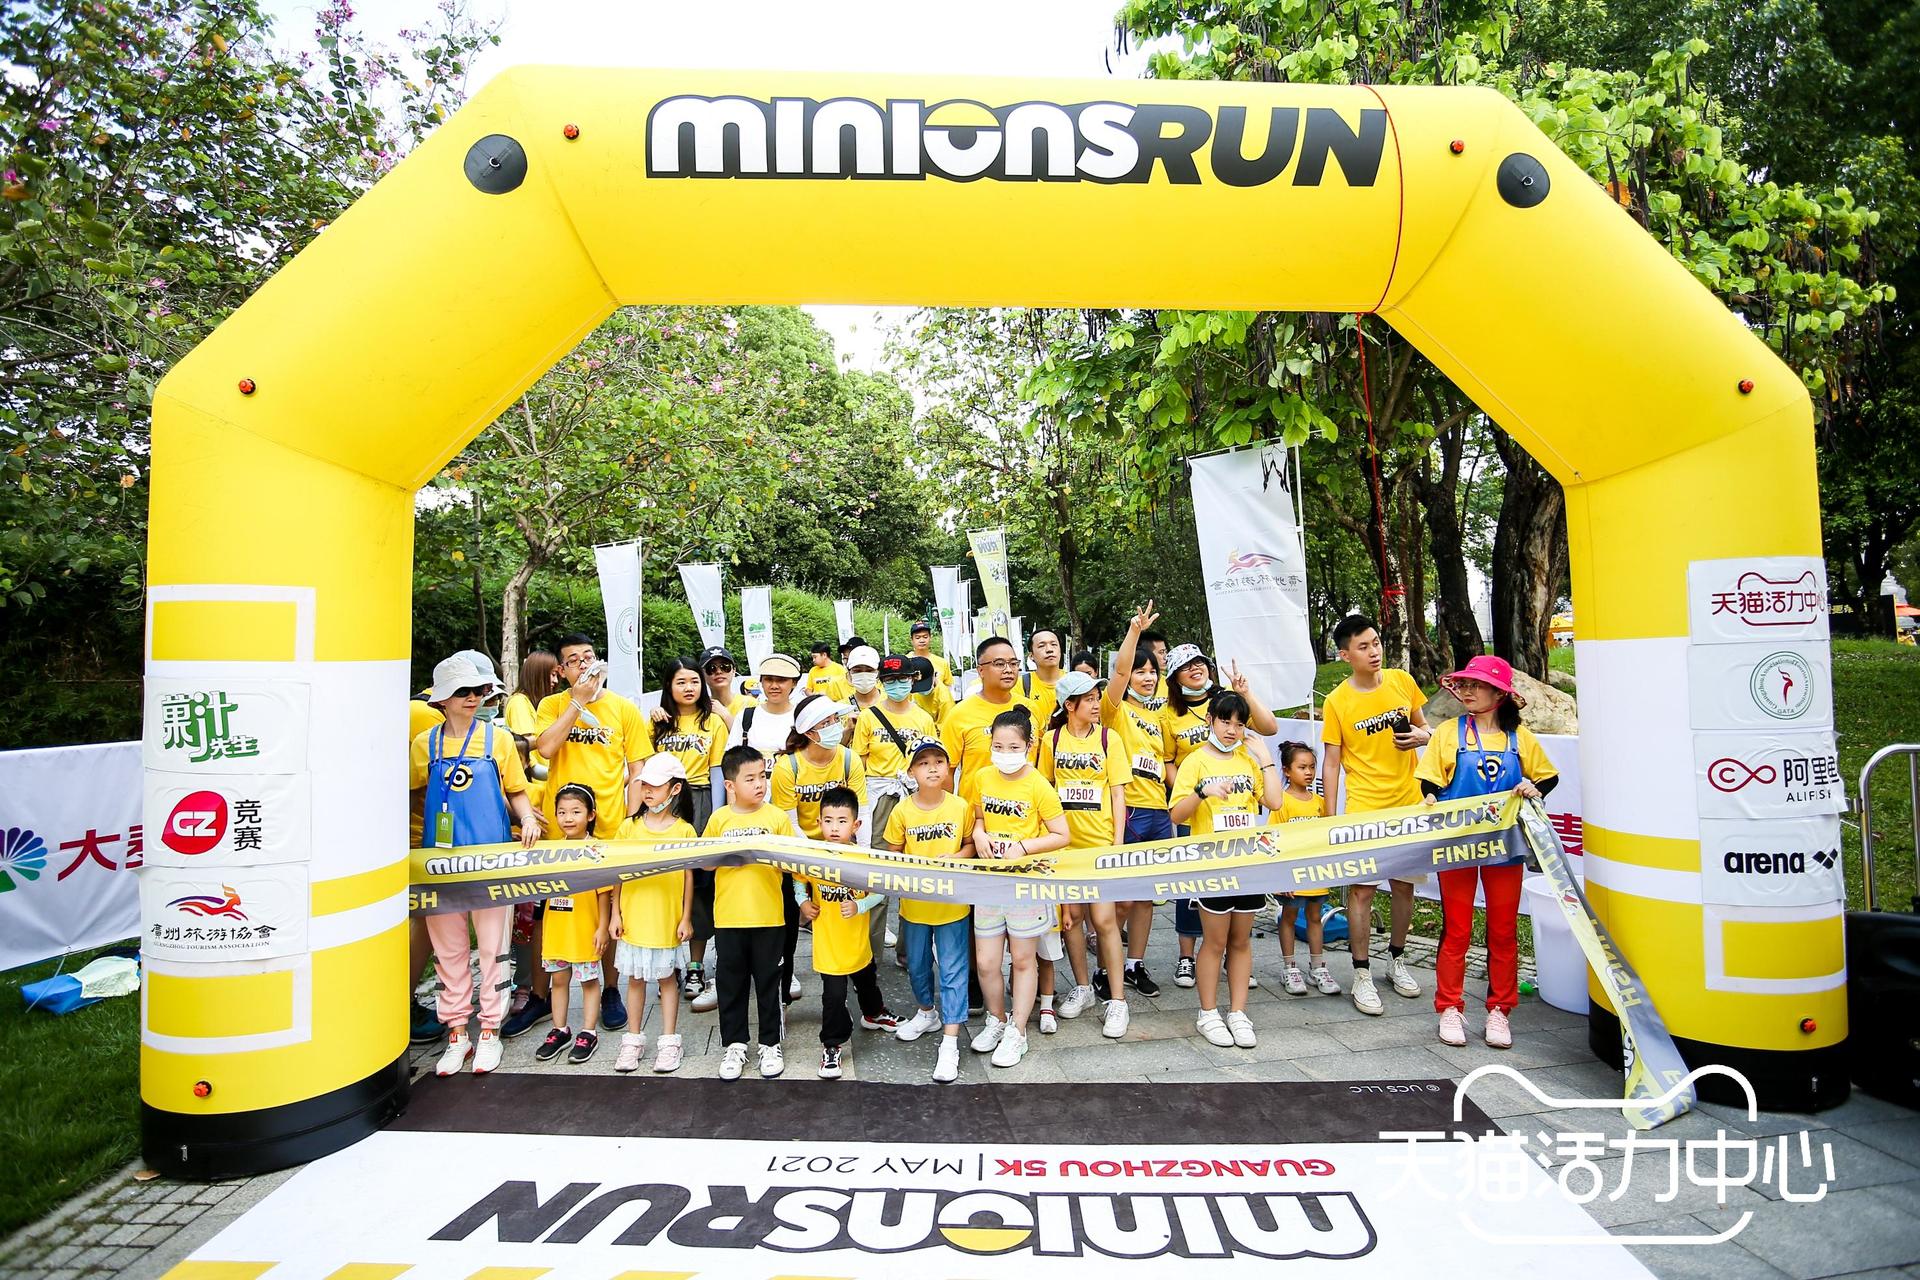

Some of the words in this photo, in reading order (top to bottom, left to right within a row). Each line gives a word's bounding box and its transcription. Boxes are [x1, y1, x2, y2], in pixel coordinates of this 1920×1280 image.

[1189, 732, 1210, 746] RU
[1056, 758, 1088, 770] RUN
[800, 791, 823, 803] RU
[1066, 788, 1094, 801] 12502
[984, 802, 1013, 816] RUN
[172, 810, 217, 836] GZ
[233, 799, 263, 851] 竞赛
[1223, 814, 1250, 829] 10647
[916, 829, 943, 842] RUN
[1431, 839, 1507, 865] FINISH
[1293, 858, 1378, 884] FINISH
[1724, 851, 1805, 875] arena
[487, 879, 570, 901] FINISH
[867, 872, 955, 896] FINISH
[1015, 882, 1100, 901] FINISH
[1154, 876, 1239, 896] FINISH
[187, 943, 217, 951] TOURISM
[219, 941, 271, 951] ASSOCIATION
[1348, 1084, 1384, 1095] LLC
[1387, 1083, 1424, 1094] UCS
[767, 1154, 856, 1174] 2021
[873, 1156, 963, 1177] MAY
[994, 1158, 1047, 1177] 5K
[1059, 1159, 1336, 1179] GUANGZHOU
